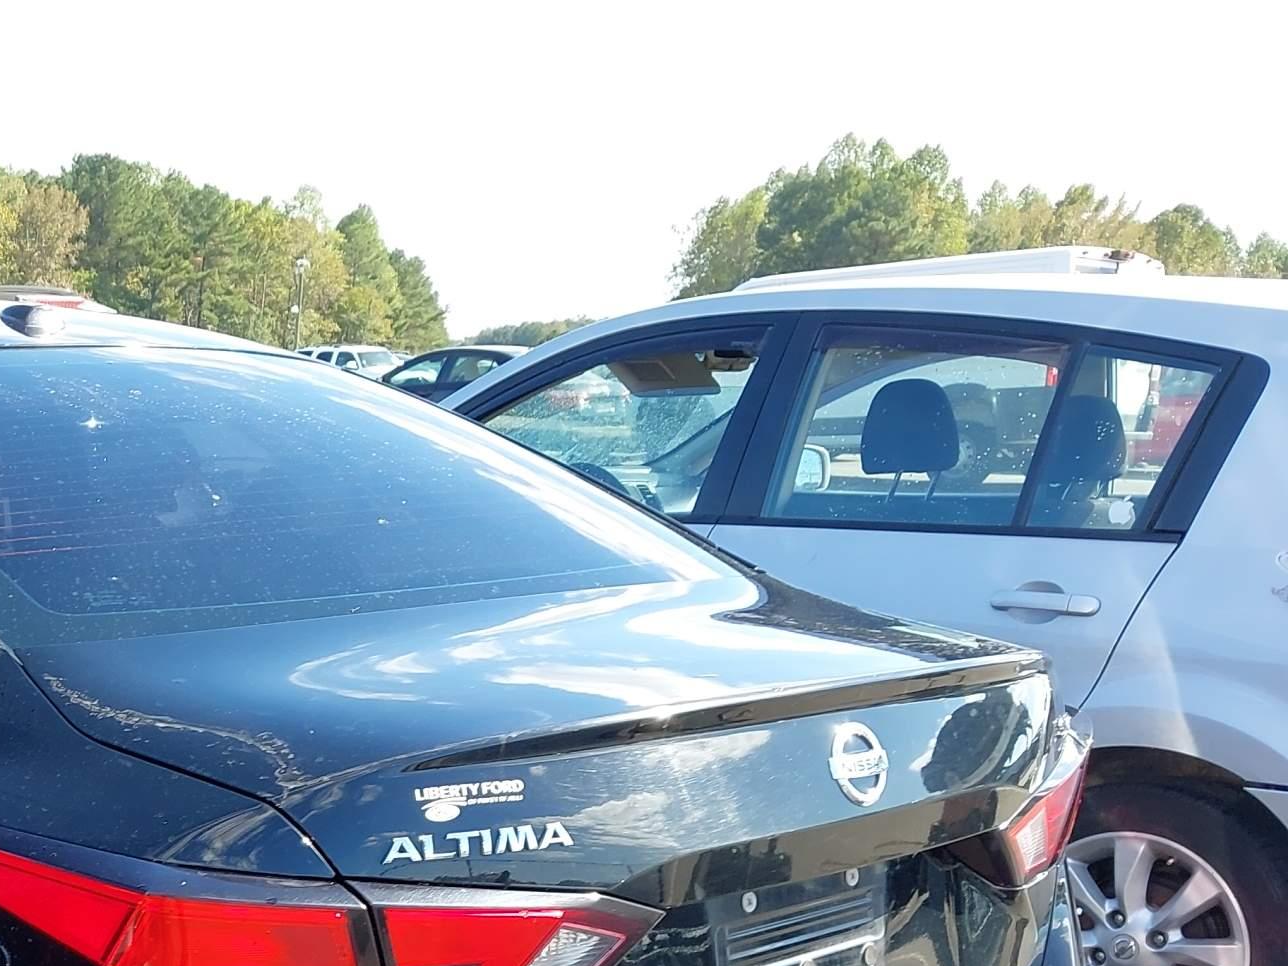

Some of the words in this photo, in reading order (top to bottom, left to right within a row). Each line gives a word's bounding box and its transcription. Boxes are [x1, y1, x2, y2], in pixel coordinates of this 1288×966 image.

[414, 782, 479, 801] LIBERTY
[481, 779, 525, 796] FORD
[383, 821, 575, 865] ALTIMA
